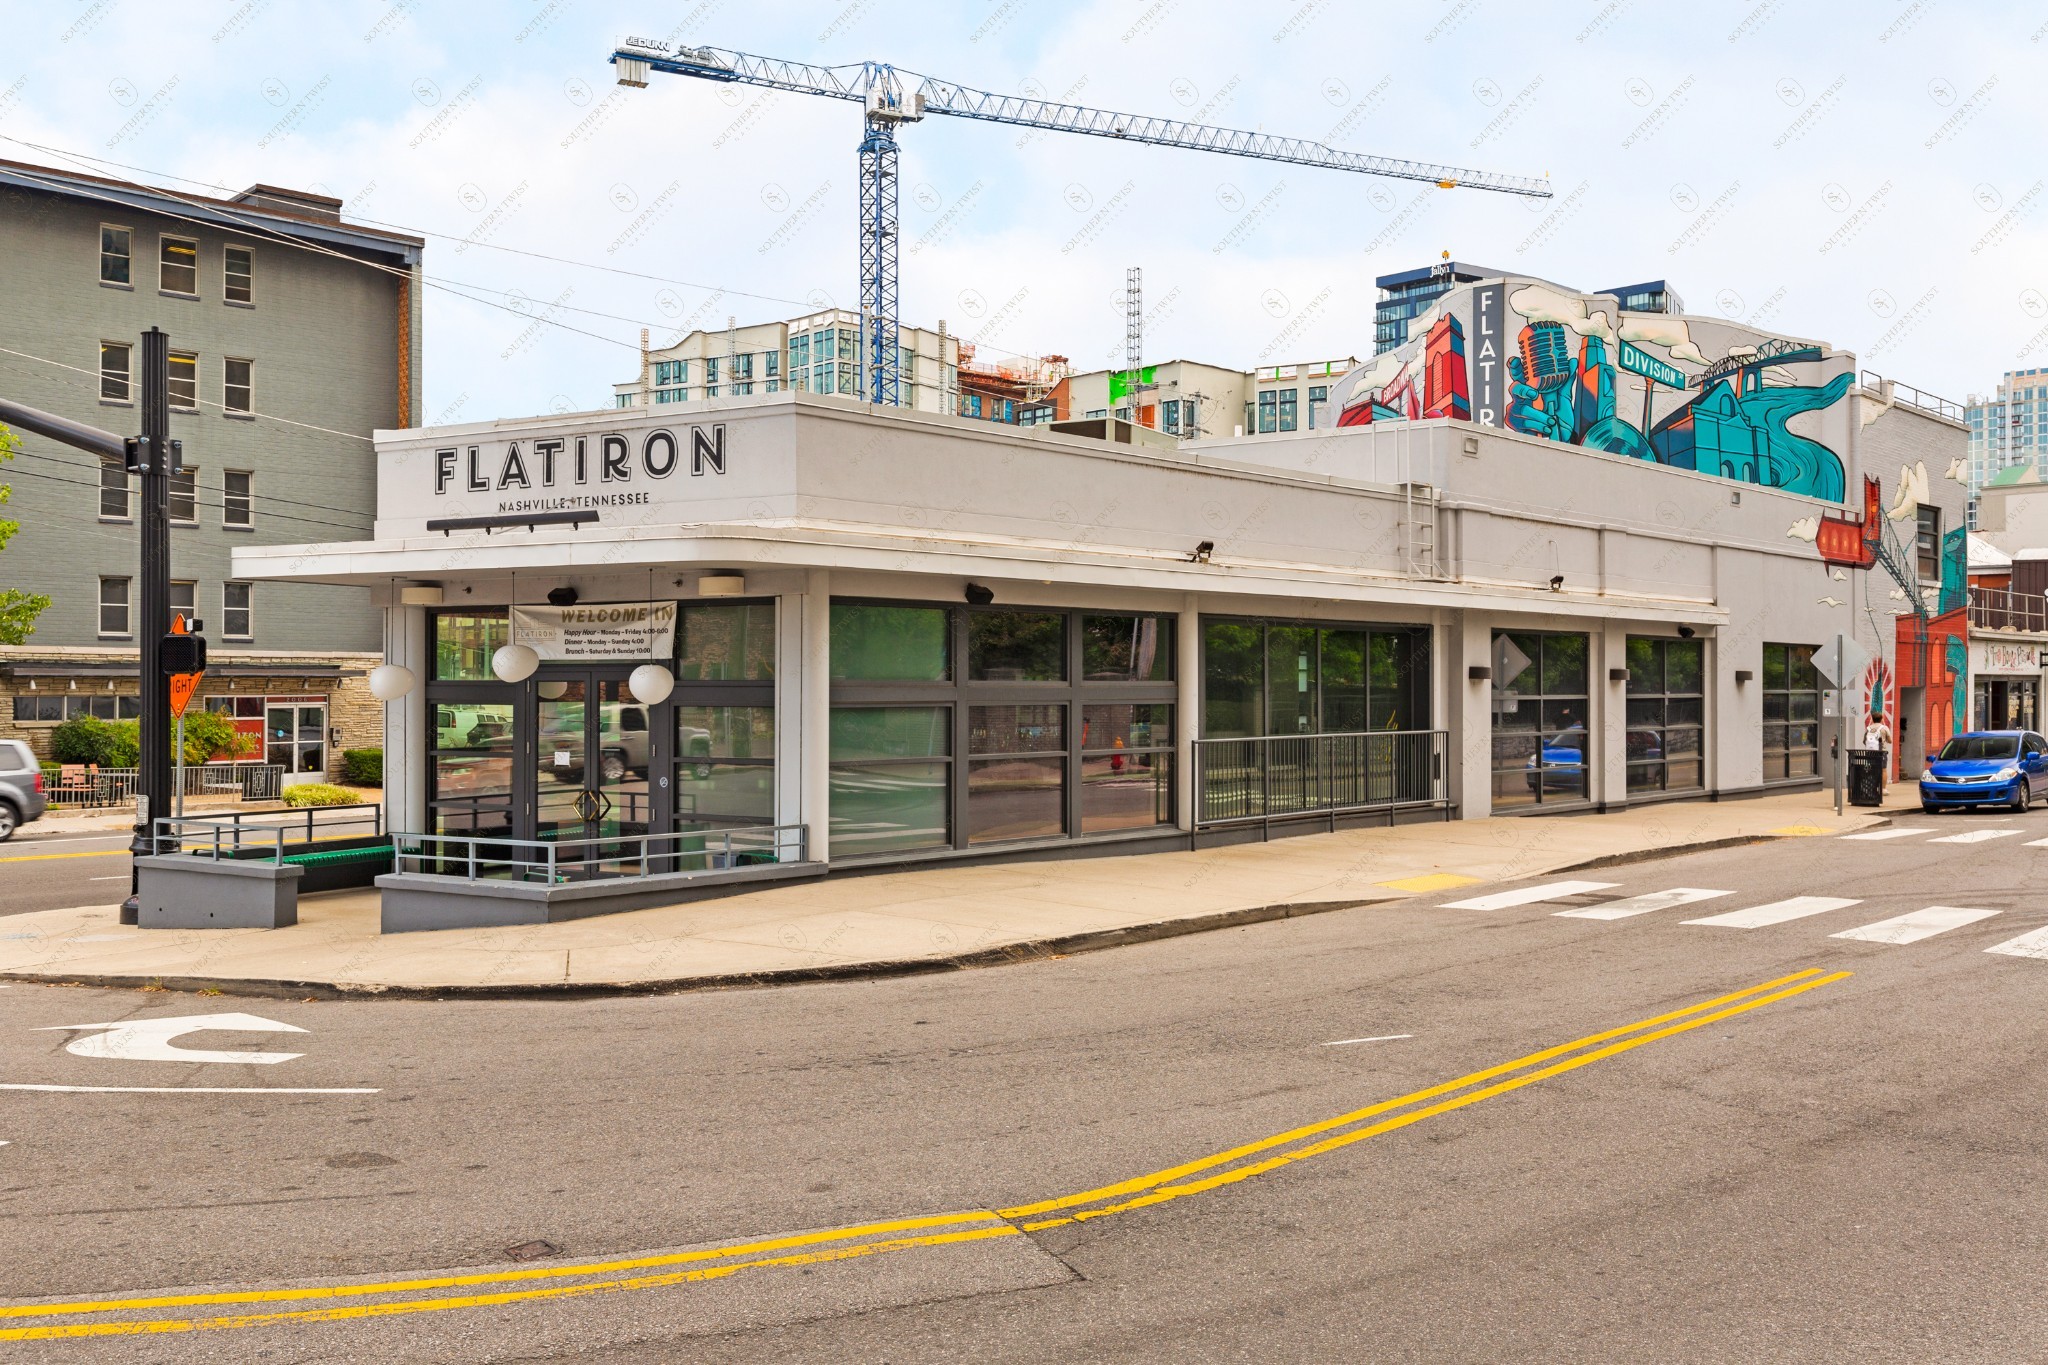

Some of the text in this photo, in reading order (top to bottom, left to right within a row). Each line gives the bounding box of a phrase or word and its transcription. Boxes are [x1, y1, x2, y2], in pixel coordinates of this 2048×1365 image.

[1624, 346, 1676, 384] DIVISION
[435, 424, 726, 494] FLATIRON
[576, 492, 650, 507] TENNESSEE
[561, 606, 673, 623] WELCOME IN
[564, 629, 581, 637] Happy
[612, 638, 630, 646] Sunday
[172, 679, 192, 693] IGHT
